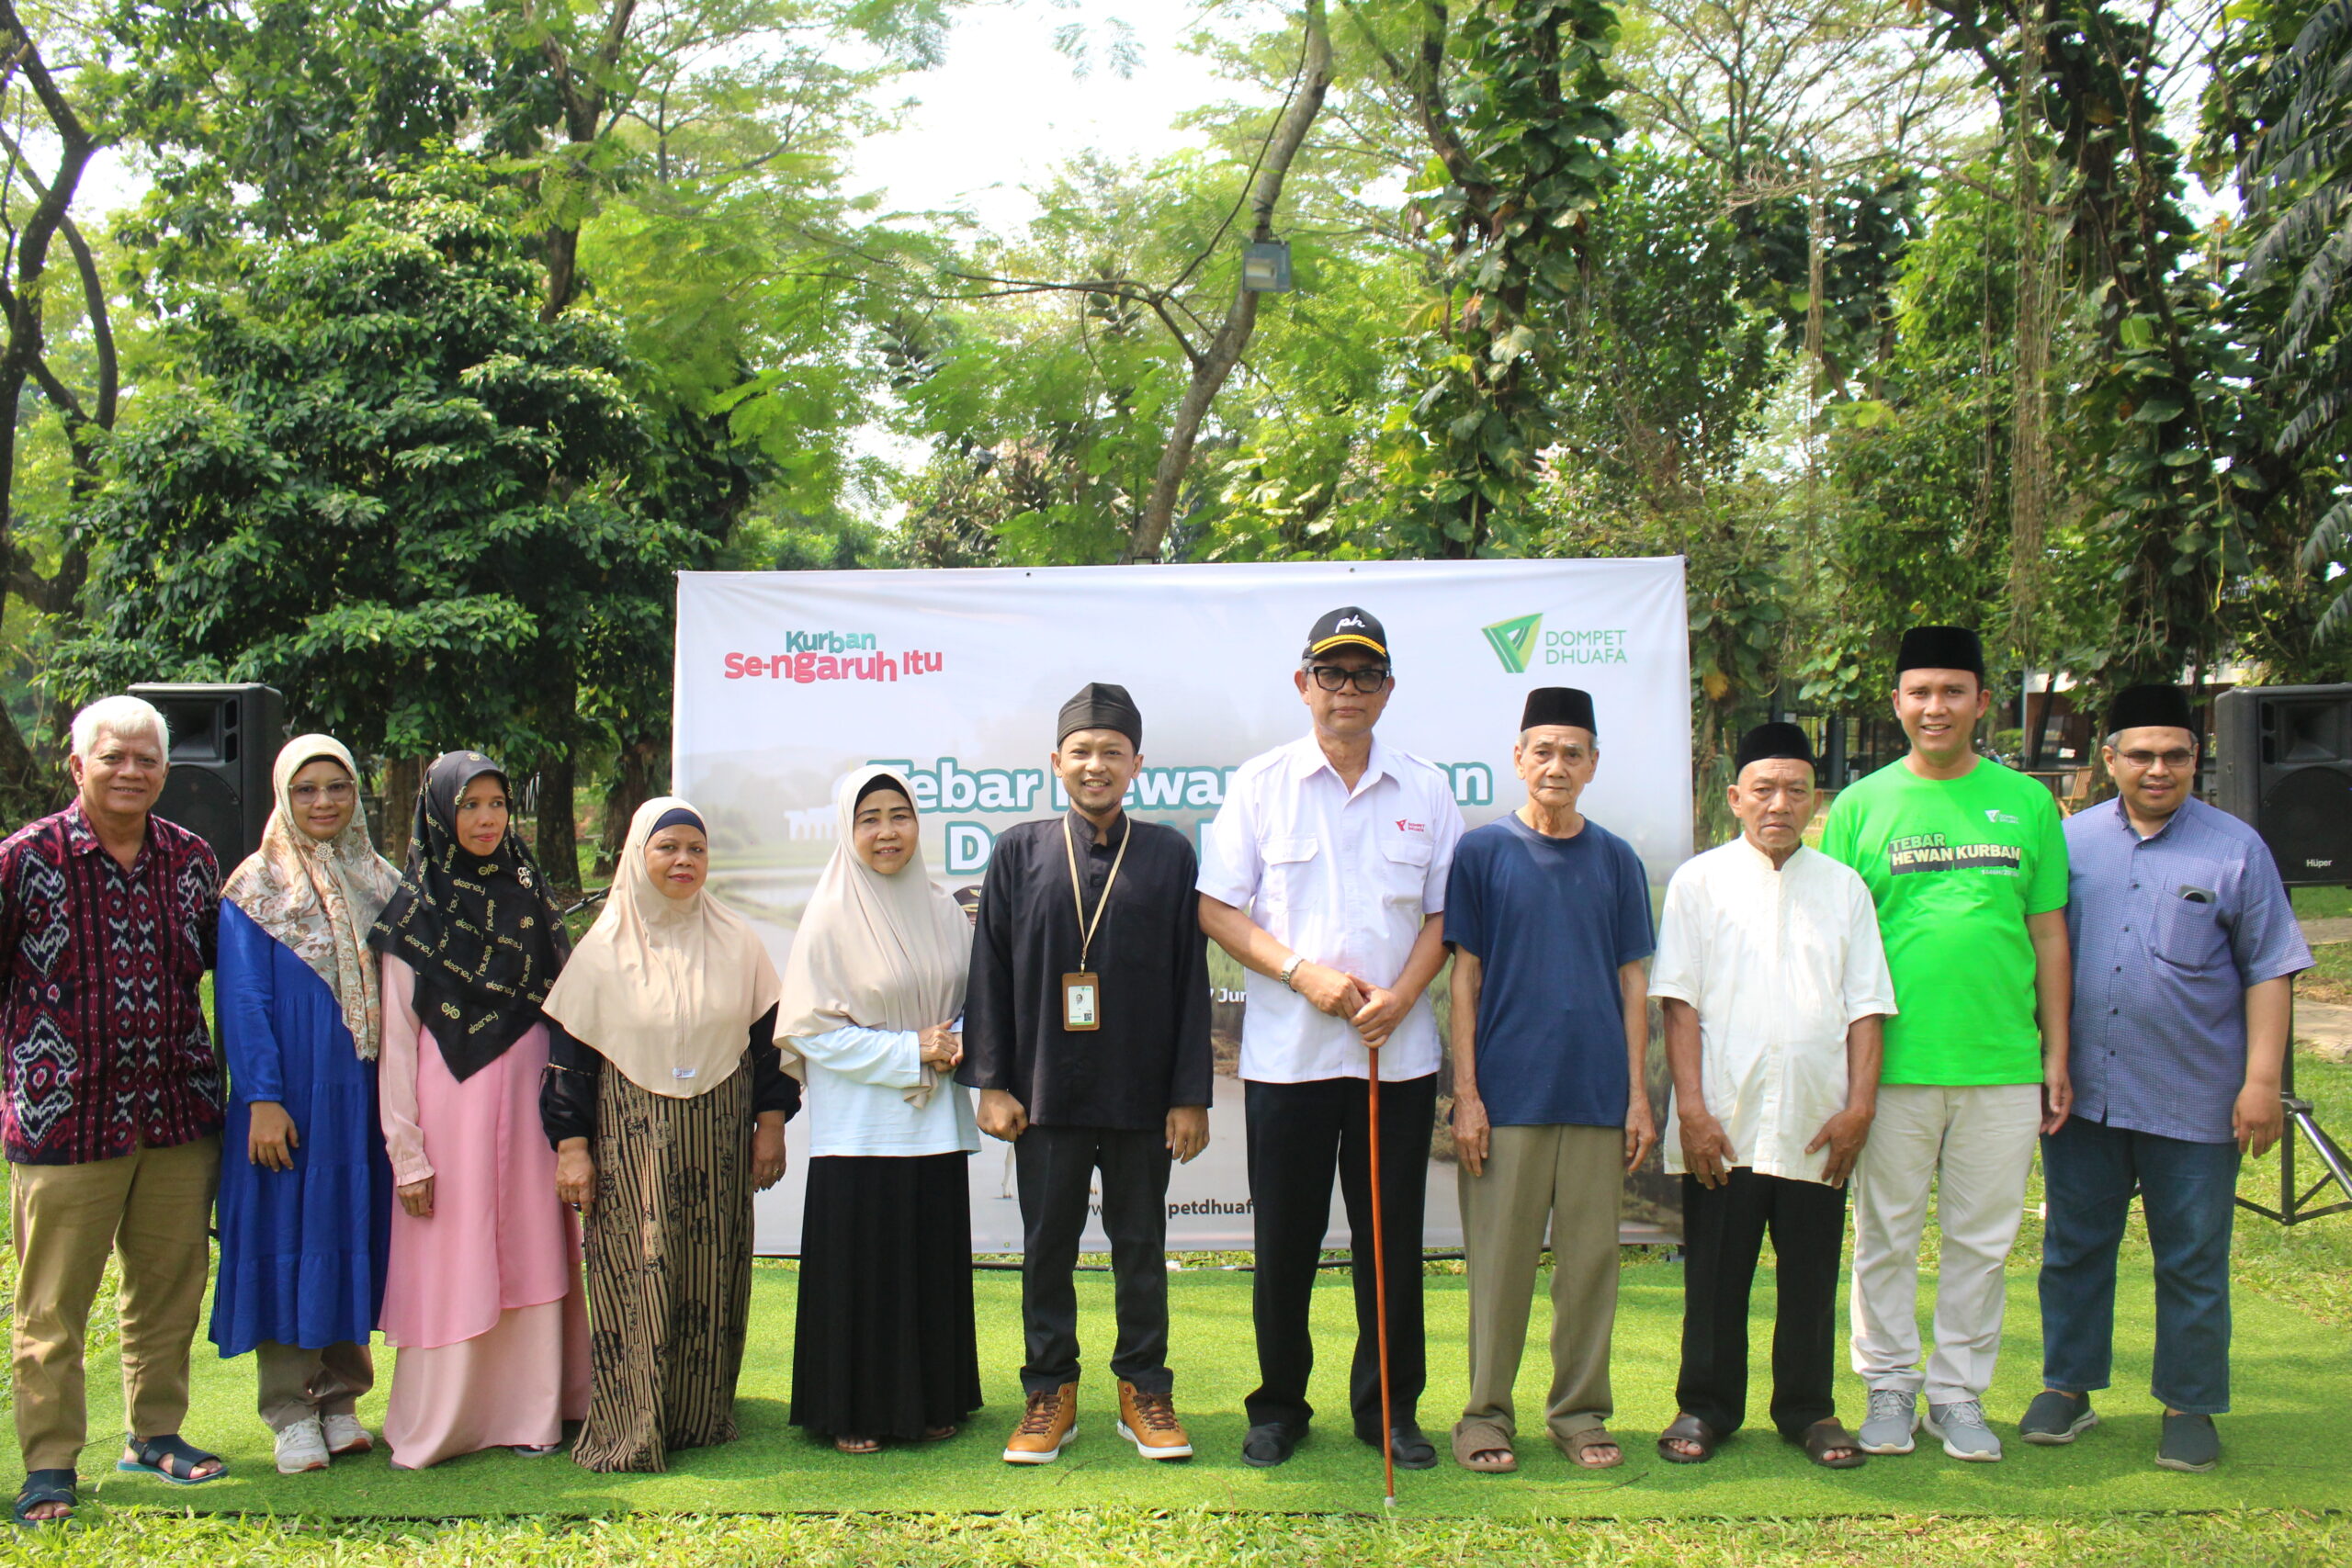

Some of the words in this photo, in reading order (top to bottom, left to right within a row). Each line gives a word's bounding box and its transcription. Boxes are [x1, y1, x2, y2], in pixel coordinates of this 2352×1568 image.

[1335, 615, 1365, 633] ph
[786, 630, 876, 653] Kurban
[1545, 630, 1627, 647] DOMPET
[724, 651, 898, 683] Se-ngaruh
[903, 650, 943, 675] Itu
[1545, 649, 1628, 664] DHUAFA
[1890, 833, 1946, 852] TEBAR
[1892, 847, 1953, 867] HEWAN
[1955, 843, 2021, 862] KURBAN
[453, 877, 485, 896] deeney
[405, 934, 435, 957] deeney
[443, 959, 473, 983] deeney
[475, 945, 494, 976] deeney
[468, 1010, 499, 1034] deeney
[1168, 1199, 1253, 1219] petdhuaf
